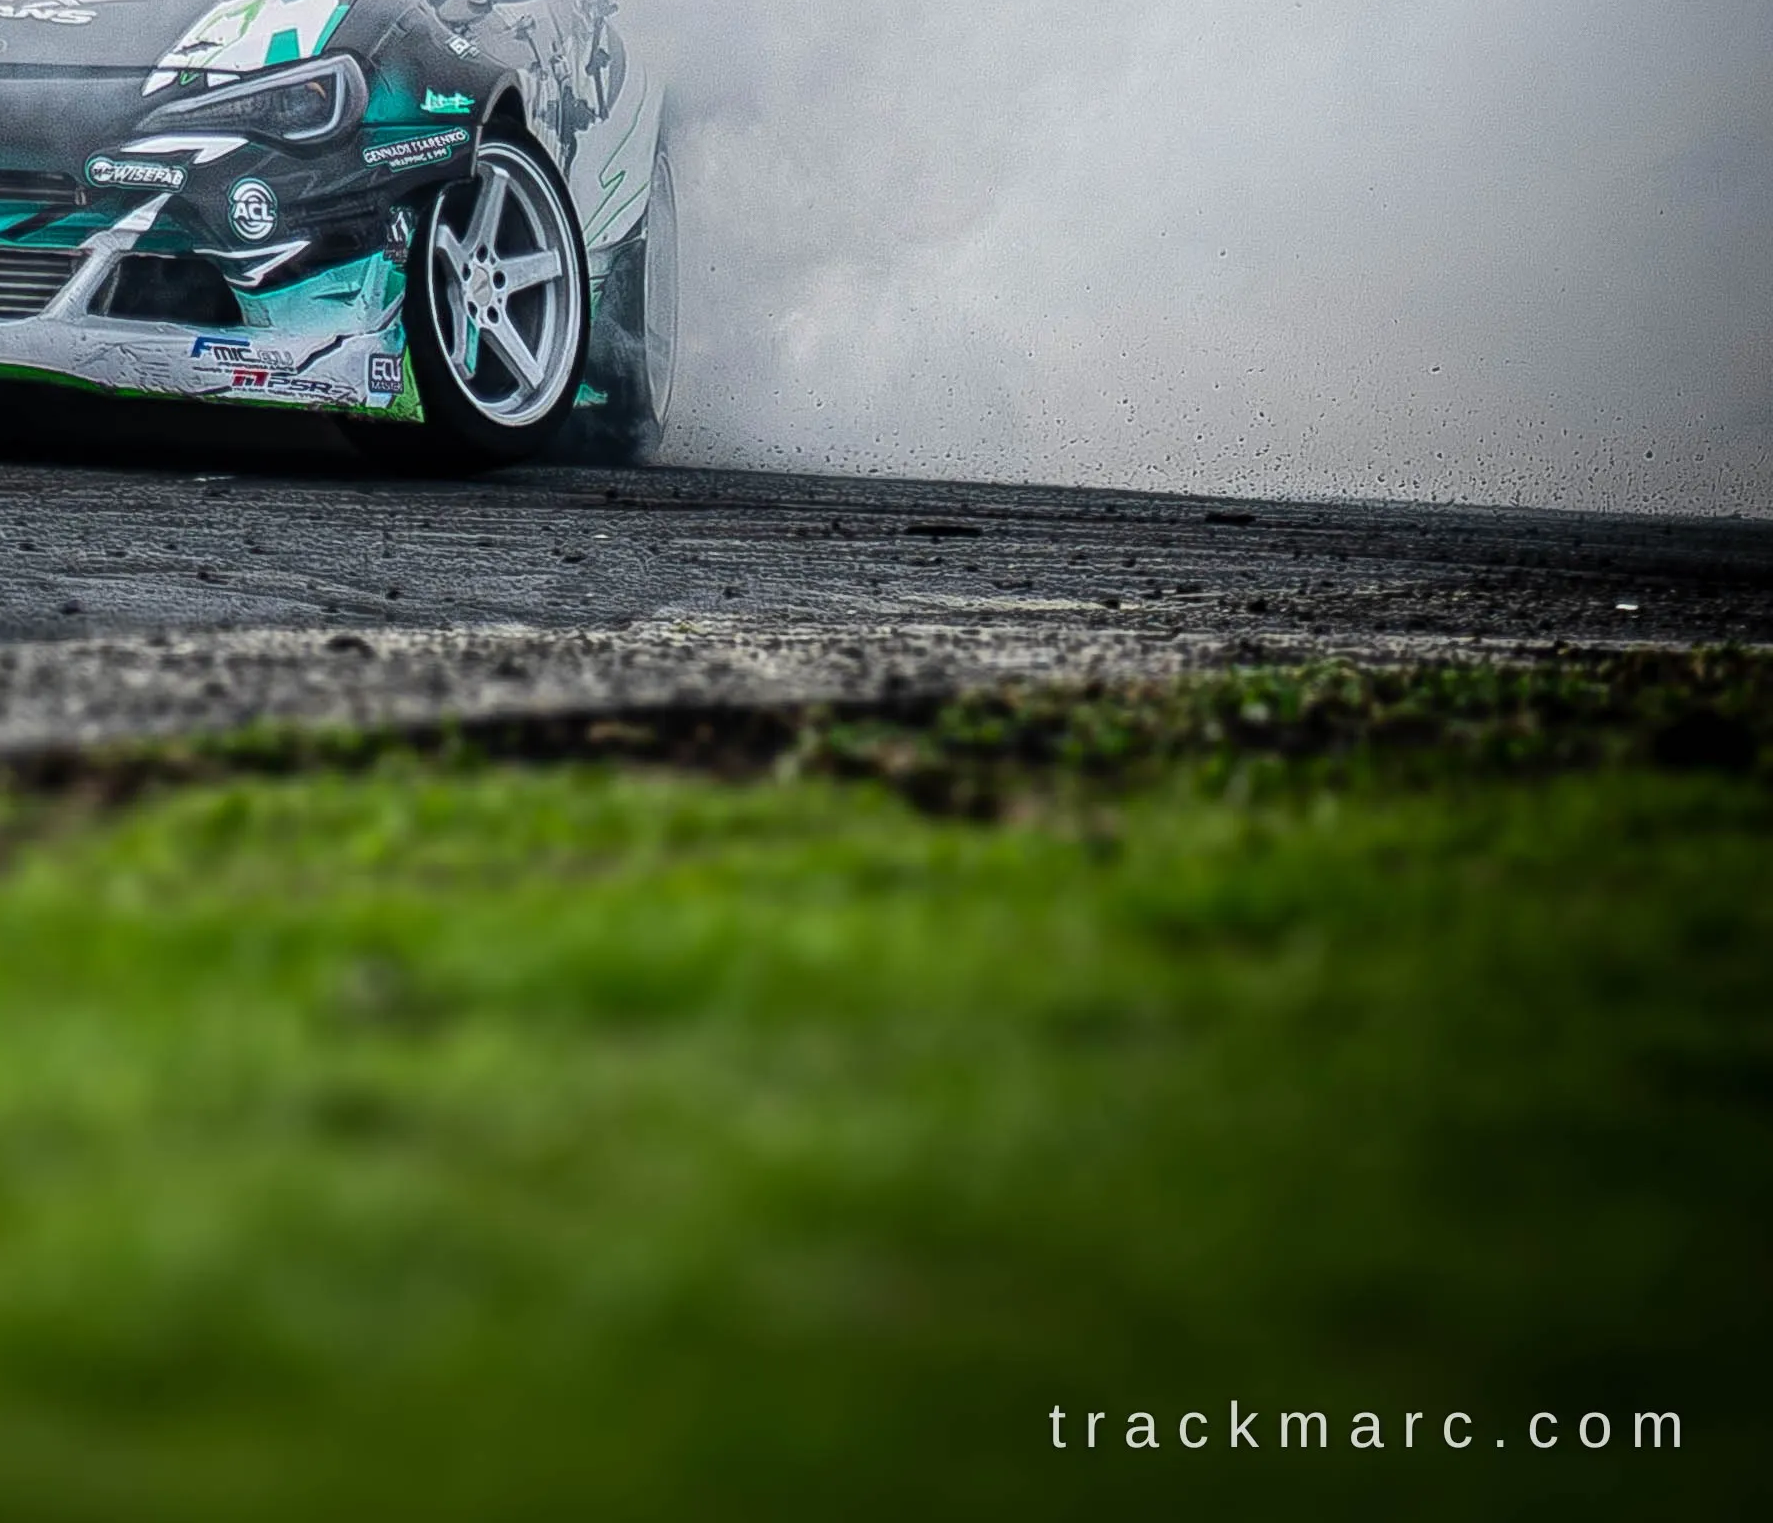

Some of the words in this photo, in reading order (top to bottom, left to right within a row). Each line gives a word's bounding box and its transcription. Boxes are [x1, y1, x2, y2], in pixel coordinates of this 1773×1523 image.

[114, 165, 184, 186] WISEFAB
[233, 202, 274, 222] ACL
[371, 357, 402, 382] ECU
